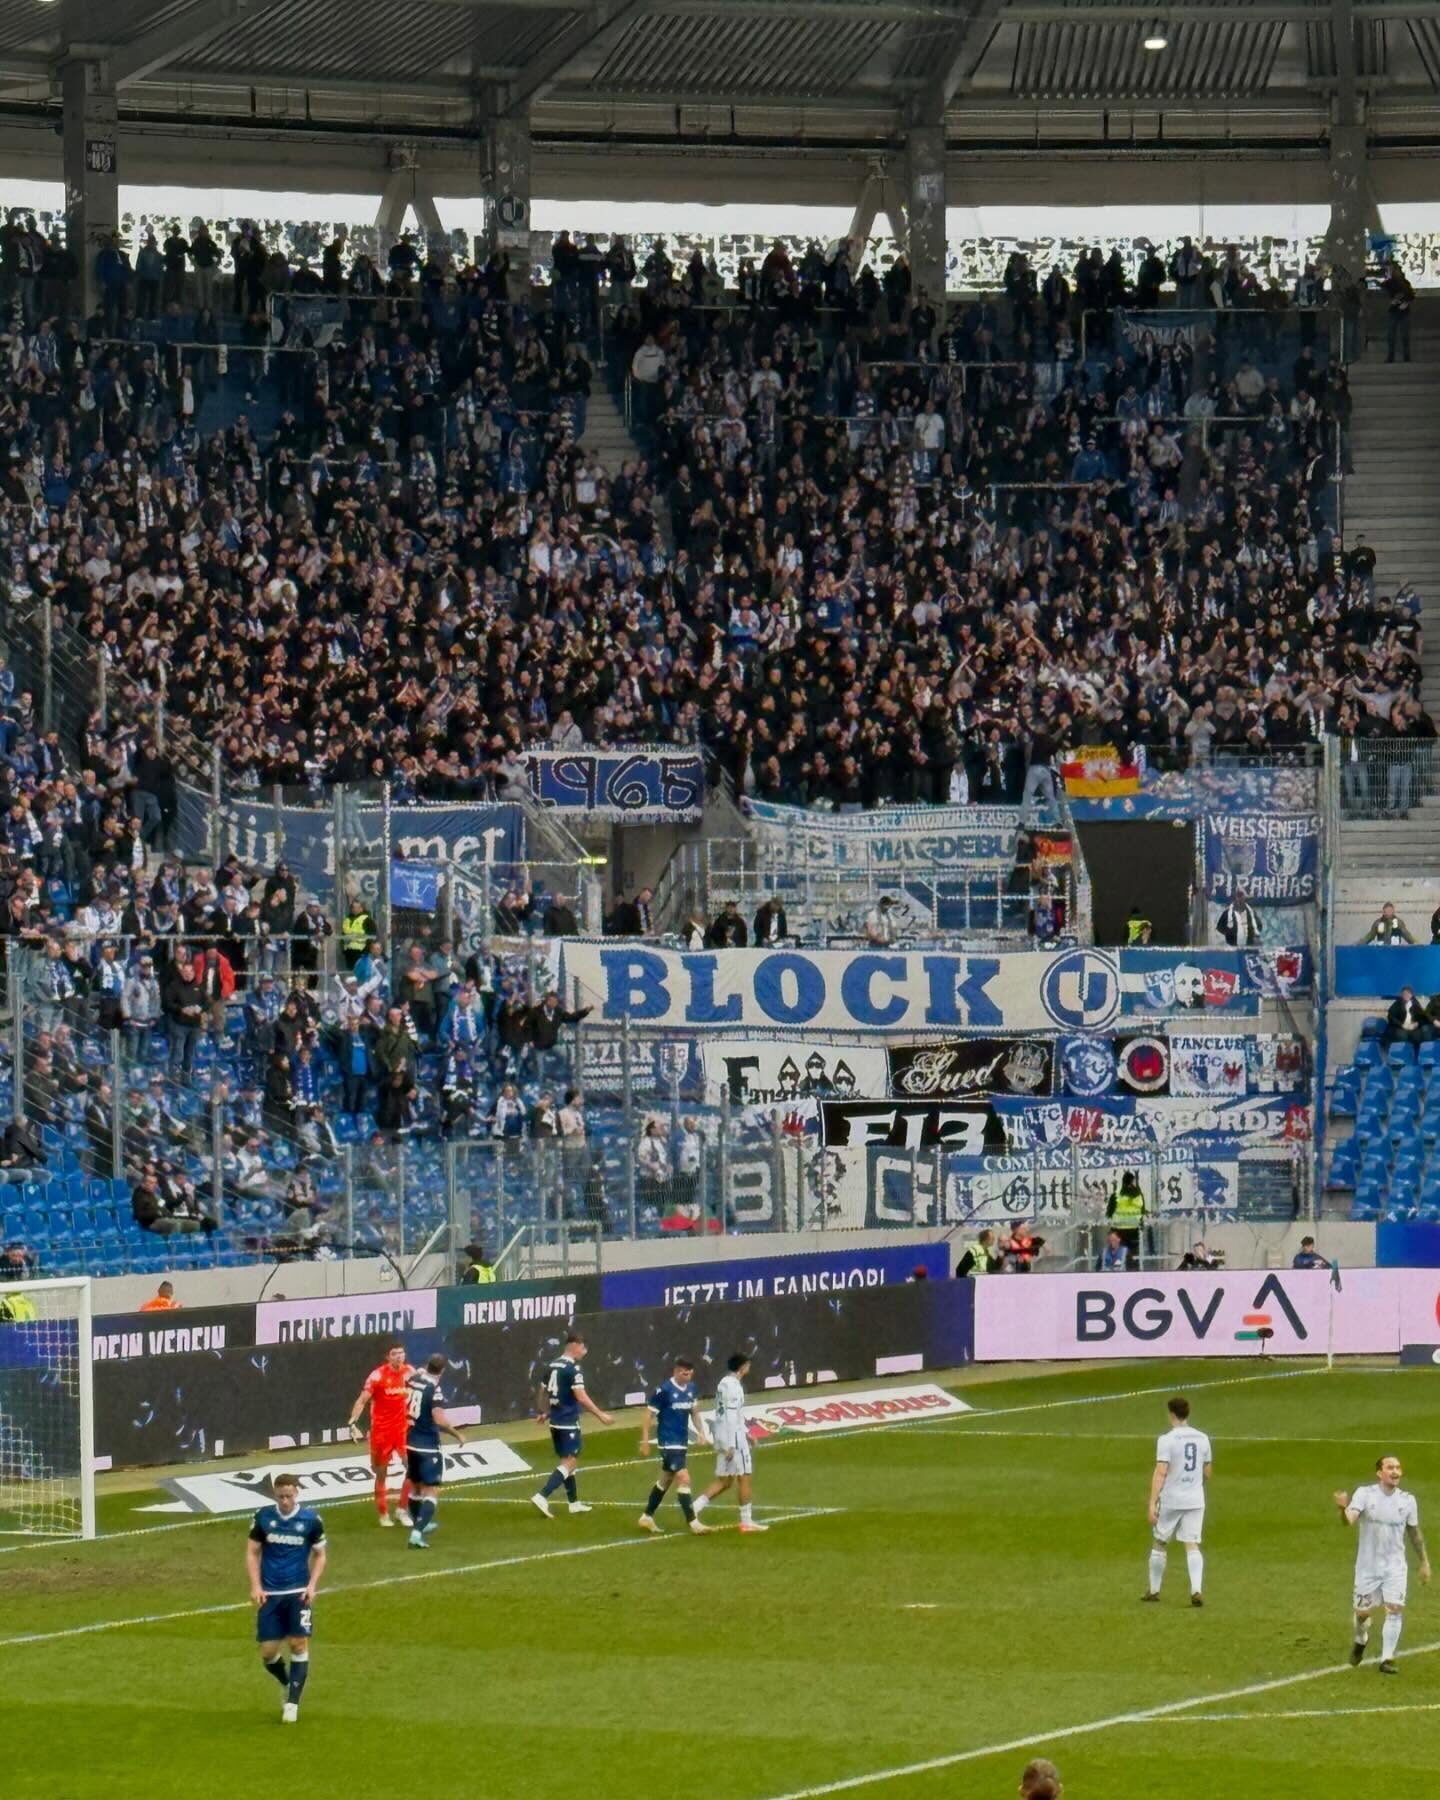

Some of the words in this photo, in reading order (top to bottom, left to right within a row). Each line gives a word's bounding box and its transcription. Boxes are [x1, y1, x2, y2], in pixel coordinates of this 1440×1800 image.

[525, 755, 698, 811] 1965
[1212, 873, 1313, 898] PIRANHAS
[600, 950, 1003, 1026] BLOCK
[547, 1369, 559, 1397] 4
[1184, 1442, 1198, 1472] 9
